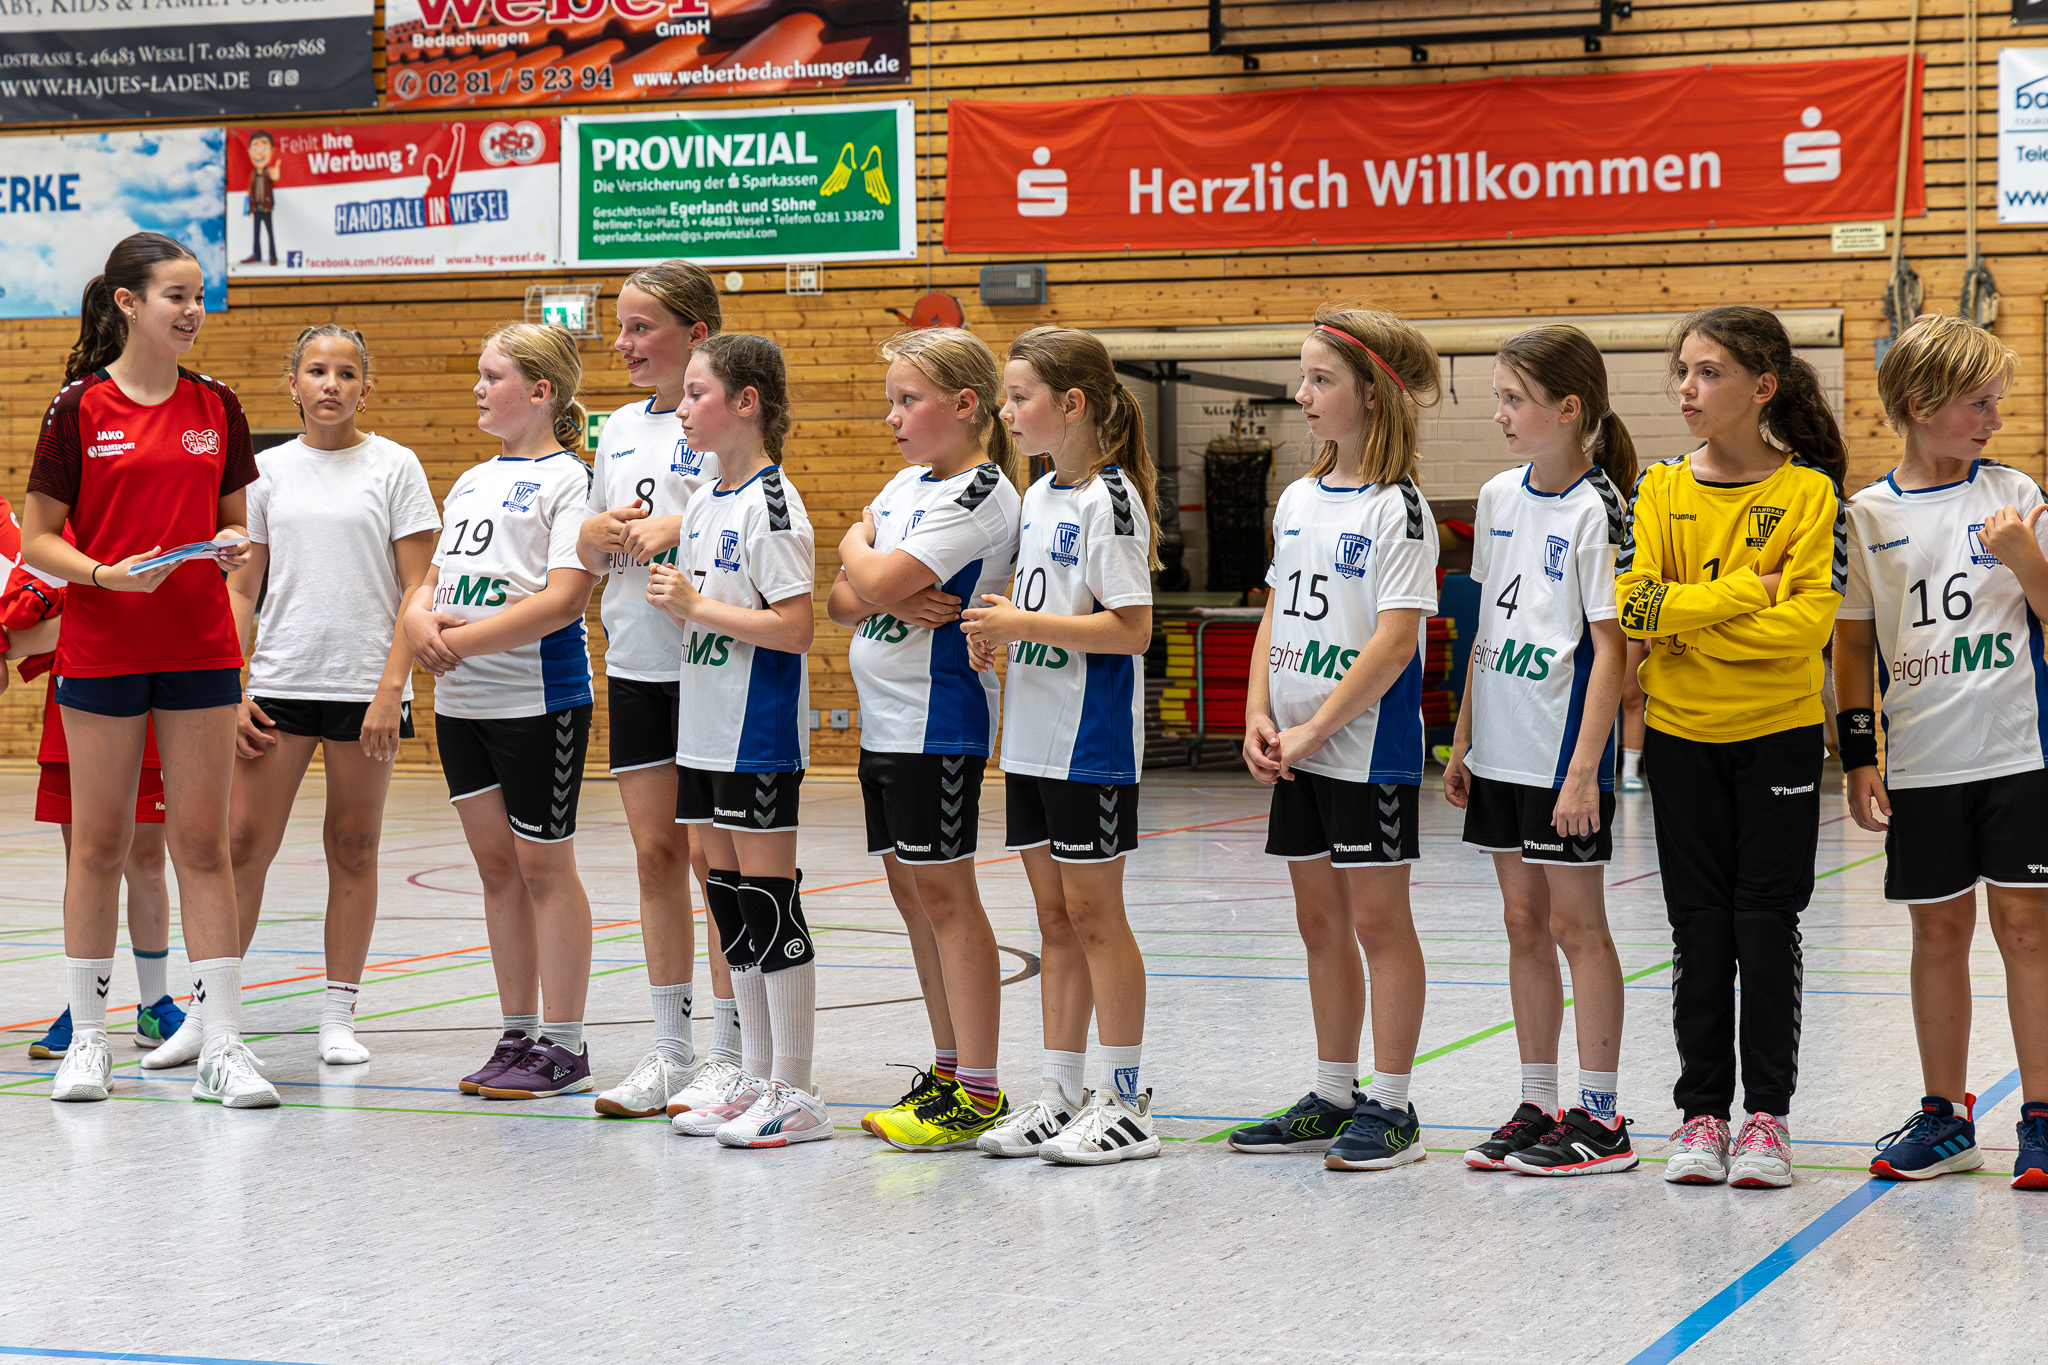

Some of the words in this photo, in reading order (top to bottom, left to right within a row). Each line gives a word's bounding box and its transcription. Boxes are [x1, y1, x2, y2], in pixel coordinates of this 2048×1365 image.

[655, 20, 711, 37] GmbH
[412, 32, 529, 48] Bedachungen
[90, 48, 135, 66] 46483
[197, 42, 213, 60] T.
[216, 41, 249, 60] 0281
[254, 37, 326, 60] 20677868
[428, 72, 458, 95] 02
[464, 70, 492, 94] 81
[519, 68, 535, 92] 5
[543, 66, 573, 91] 23
[581, 63, 613, 89] 94
[632, 54, 900, 88] www.weberbedachungen.de
[0, 71, 250, 99] WWW.HAJUES-LADEN.DE
[280, 135, 319, 154] Fehlt
[322, 133, 353, 151] Ihre
[489, 131, 535, 153] HSG
[591, 131, 818, 171] PROVINZIAL
[308, 152, 403, 175] Werbung
[593, 179, 615, 193] Die
[616, 177, 701, 193] Versicherung
[703, 174, 725, 190] der
[742, 174, 818, 190] Sparkassen
[1129, 158, 1349, 215] Herzlich
[1363, 150, 1722, 208] Willkommen
[335, 201, 424, 234] HANDBALL
[428, 198, 445, 225] IN
[450, 189, 507, 221] WESEL
[593, 205, 668, 217] Geschäftsstelle
[670, 200, 739, 217] Egerlandt
[741, 197, 769, 214] und
[771, 196, 817, 212] Söhne
[699, 216, 732, 227] 46483
[734, 214, 765, 226] Wesel
[774, 212, 812, 224] Telefon
[813, 211, 840, 224] 0281
[844, 209, 885, 222] 338270
[305, 255, 435, 269] facebook.com/HSGWesel
[445, 252, 547, 271] www.hsg-wesel.de
[96, 430, 125, 441] JAKO
[96, 442, 136, 452] TEAMSPORT
[635, 477, 656, 519] 8
[1751, 507, 1785, 516] HANDBAL
[446, 518, 494, 556] 19
[1060, 530, 1077, 554] HG
[1879, 536, 1909, 551] hummel
[722, 537, 738, 560] HG
[1344, 541, 1365, 565] HG
[694, 570, 706, 594] 7
[1016, 567, 1047, 612] 10
[1630, 582, 1650, 599] WE
[1283, 570, 1329, 621] 15
[1496, 574, 1521, 620] 4
[1909, 572, 1973, 628] 16
[1893, 632, 2015, 686] eightMS
[1783, 783, 1814, 796] hummel
[716, 807, 746, 818] hummel
[515, 817, 542, 833] hummel
[901, 842, 931, 853] hummel
[1061, 840, 1094, 851] hummel
[1339, 843, 1372, 852] hummel
[1530, 842, 1564, 852] hummel
